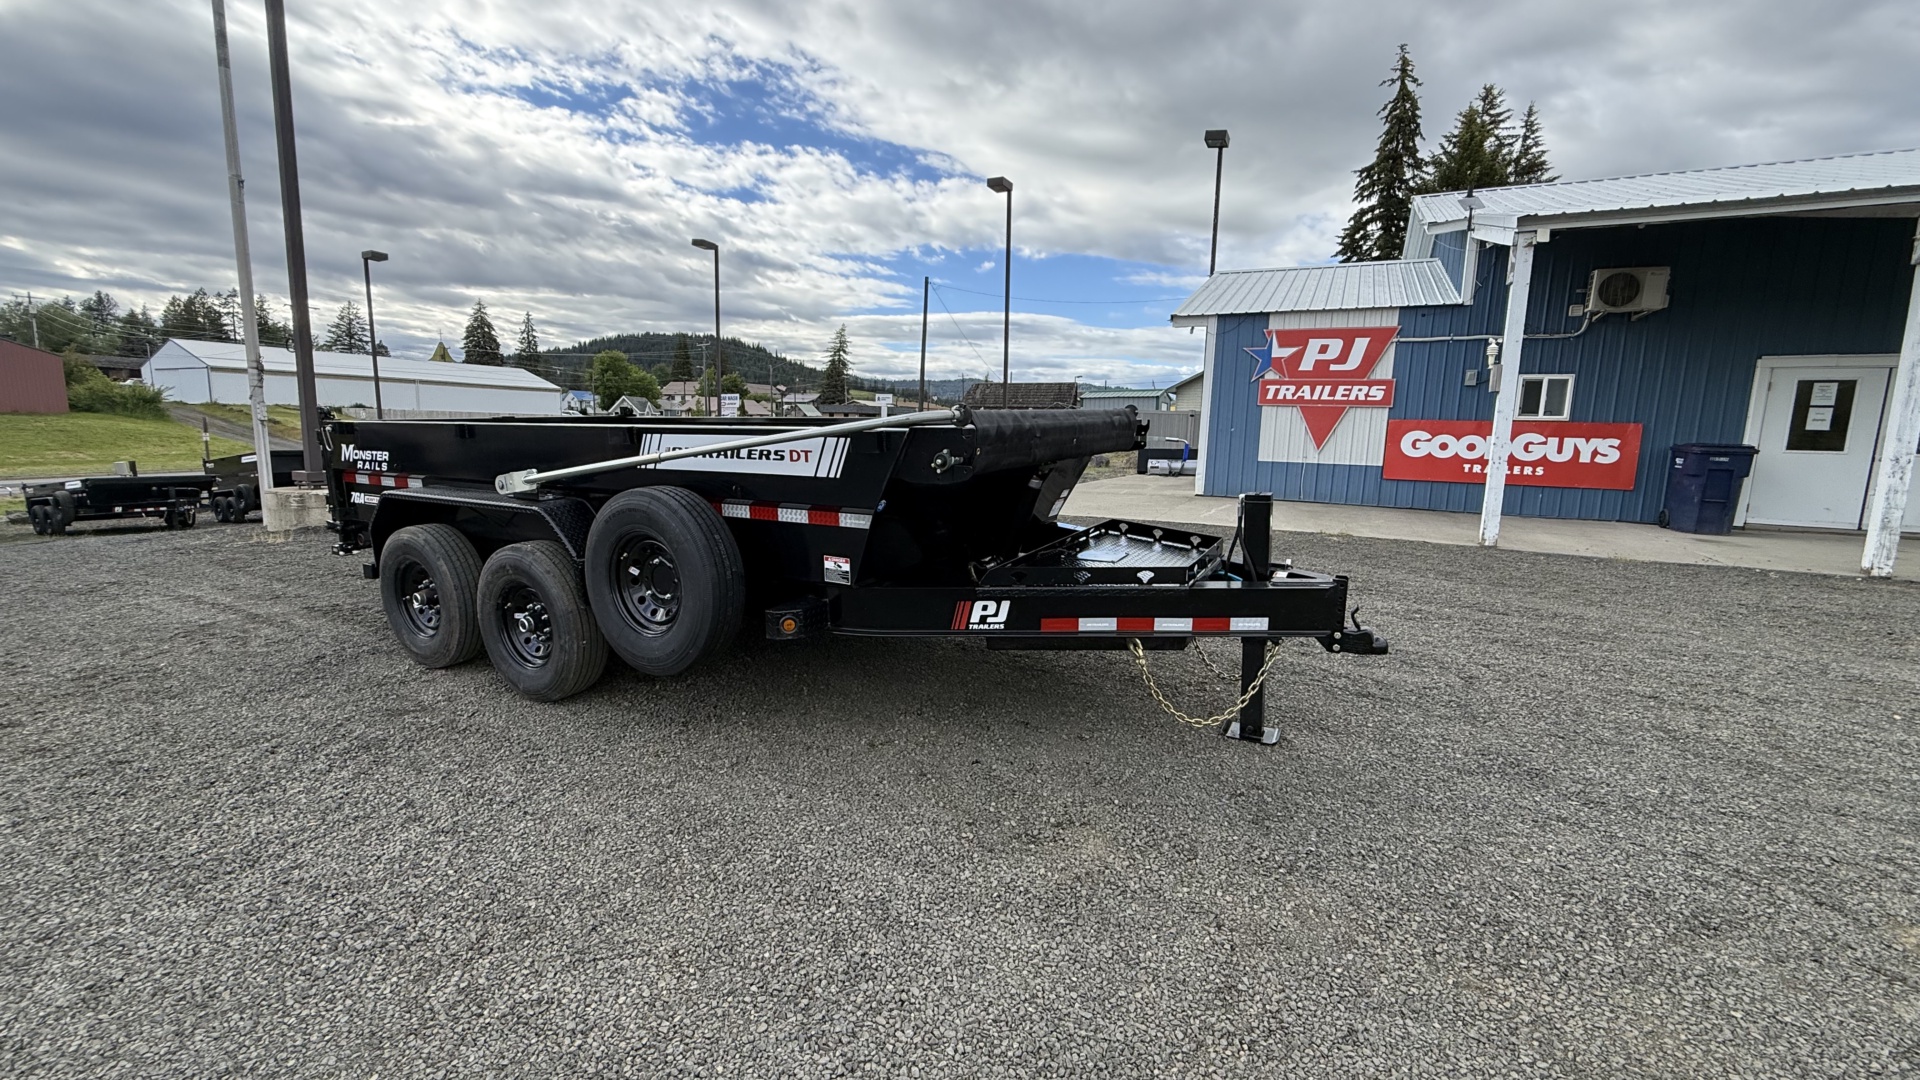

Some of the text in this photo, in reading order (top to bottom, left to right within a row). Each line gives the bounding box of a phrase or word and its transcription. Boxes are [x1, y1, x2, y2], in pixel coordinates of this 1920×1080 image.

[1298, 337, 1371, 371] PJ
[1265, 385, 1386, 401] TRAILERS
[341, 443, 389, 462] MONSTER
[789, 449, 813, 463] DT
[357, 461, 388, 471] RAILS
[1463, 463, 1545, 476] TRLERS
[351, 492, 364, 504] 7GA
[969, 600, 1011, 623] PJ
